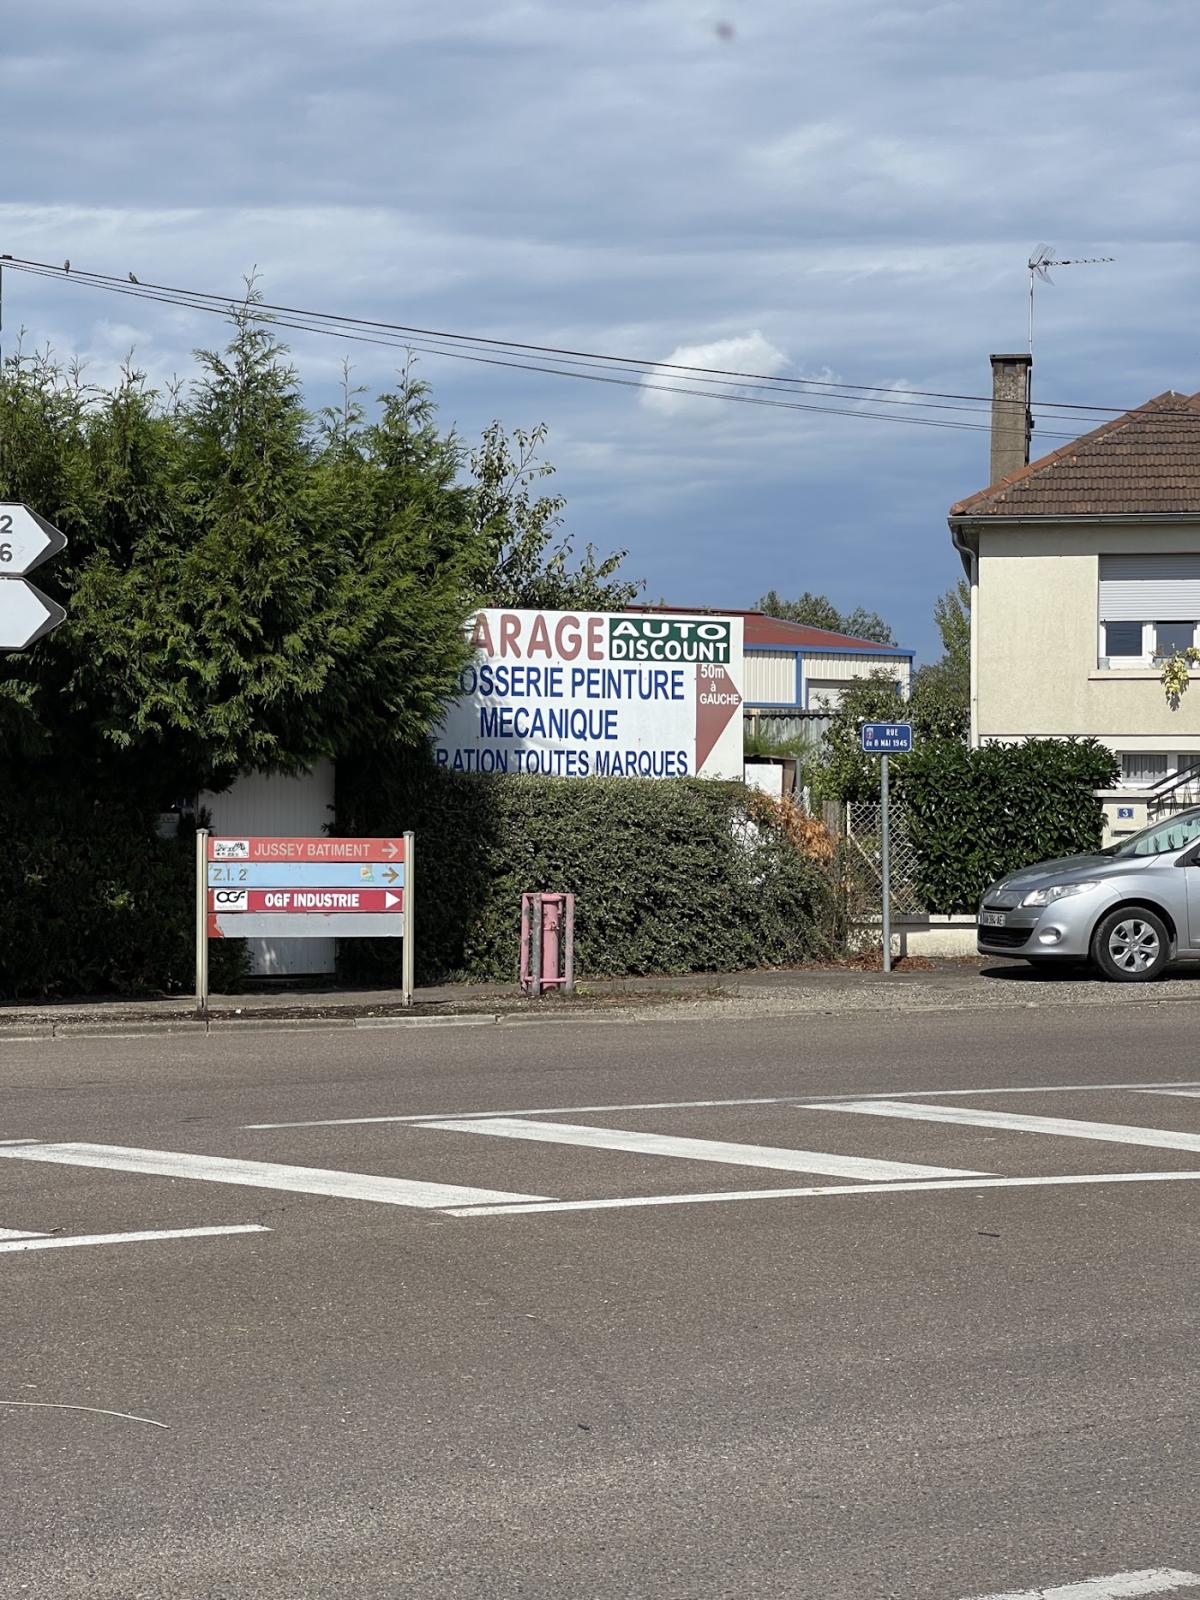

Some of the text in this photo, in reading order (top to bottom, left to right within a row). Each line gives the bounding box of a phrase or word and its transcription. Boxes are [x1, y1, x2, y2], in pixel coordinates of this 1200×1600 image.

[0, 515, 13, 534] 2
[0, 543, 13, 562] 6
[611, 621, 727, 640] AUTO
[611, 639, 728, 661] DISCOUNT
[700, 664, 725, 679] 50m
[571, 667, 685, 700] PEINTURE
[710, 681, 717, 692] à
[699, 693, 740, 705] GAUCHE
[480, 706, 618, 741] MECANIQUE
[885, 728, 899, 736] RUE
[874, 739, 880, 747] 8
[880, 739, 891, 747] MAI
[893, 739, 908, 747] 1945
[514, 749, 589, 776] TOUTES
[595, 750, 688, 777] MARQUES
[1122, 808, 1129, 817] 3
[254, 843, 371, 857] JUSSEY BATIMENT
[238, 868, 247, 881] 2
[264, 893, 360, 907] OGF INDUSTRIE
